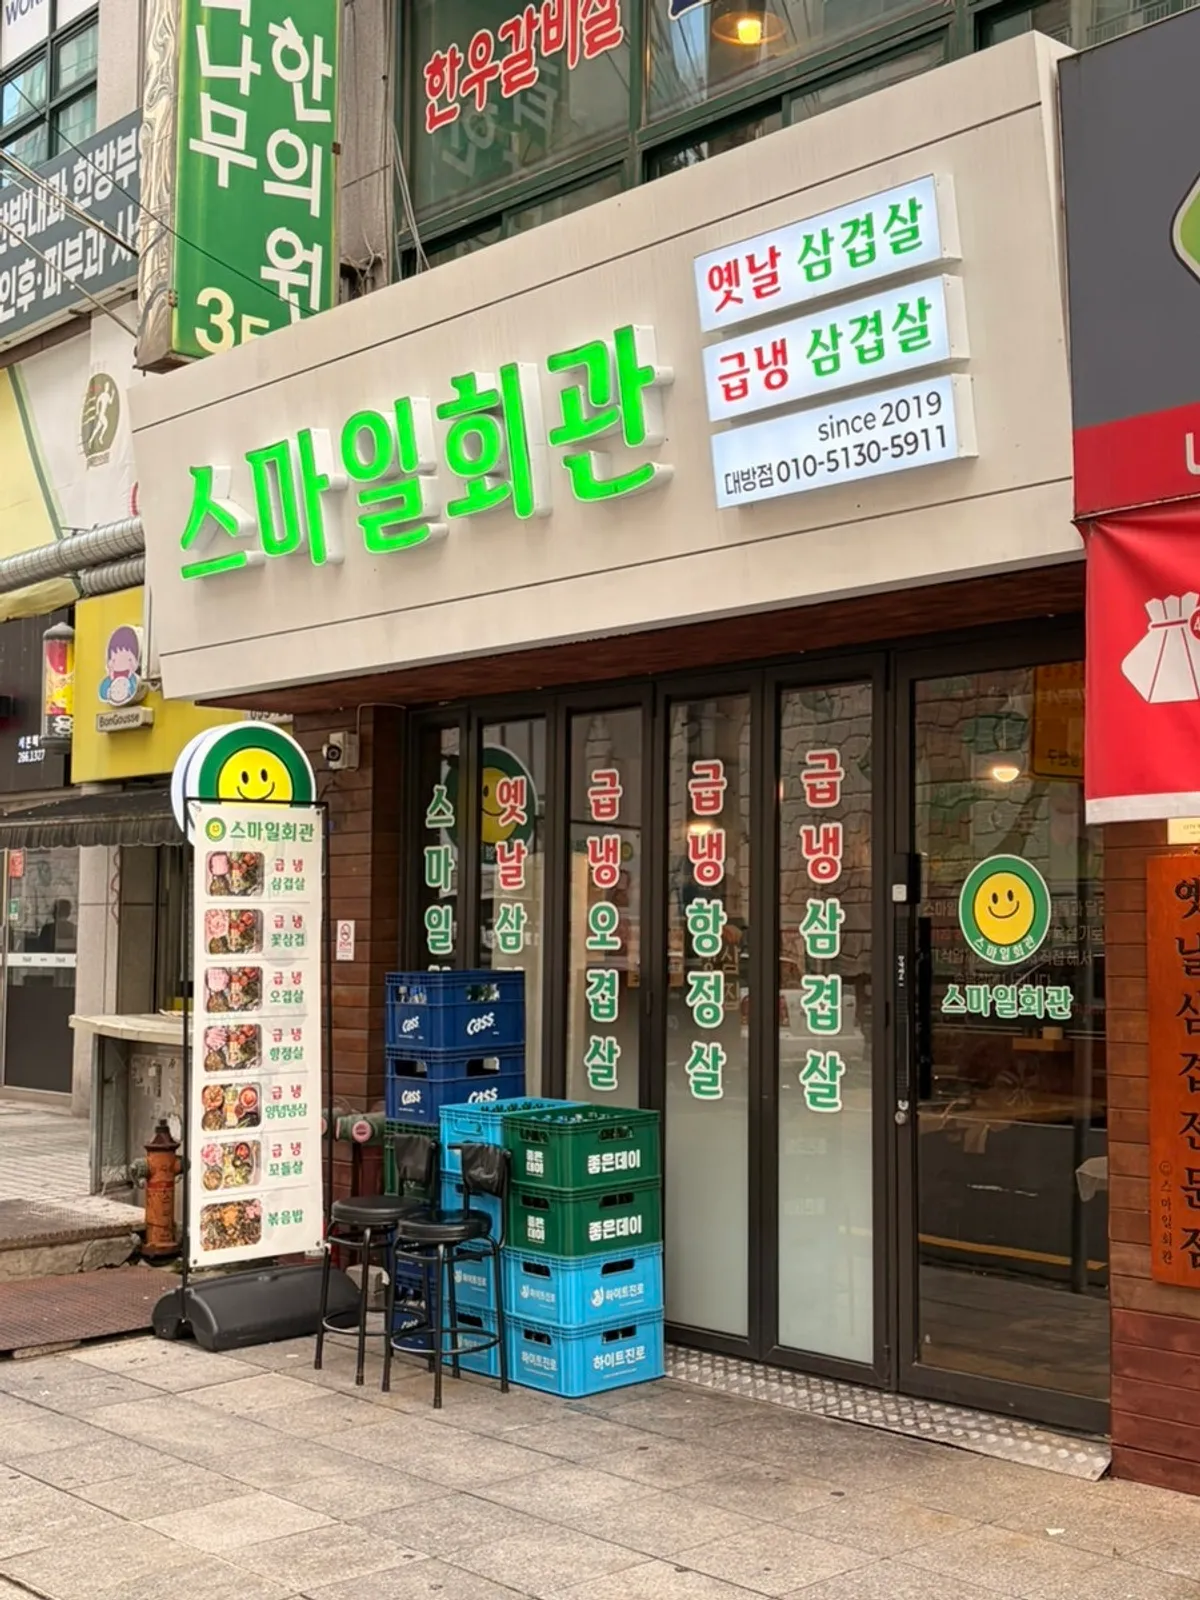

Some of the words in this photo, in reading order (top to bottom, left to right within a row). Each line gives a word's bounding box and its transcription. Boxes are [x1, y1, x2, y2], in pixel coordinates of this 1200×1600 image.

[423, 0, 625, 134] 한우갈비살
[189, 0, 262, 188] 나무
[260, 17, 333, 324] 한의원
[707, 244, 782, 313] 옛날
[796, 196, 923, 283] 삼겹살
[717, 336, 790, 402] 급냉
[805, 295, 933, 378] 삼겹살
[817, 411, 877, 442] since
[880, 390, 943, 428] 2019
[179, 324, 657, 582] 스마일회관
[724, 462, 774, 496] 대방점
[775, 424, 947, 484] 010-5130-5911
[229, 820, 314, 842] 스마일회관
[973, 937, 1036, 961] 스마일회관
[941, 984, 1074, 1020] 스마일회관
[402, 1016, 420, 1033] Cass
[467, 1012, 495, 1035] Cass
[402, 1090, 421, 1105] Cass
[468, 1087, 498, 1104] Cass
[587, 1149, 641, 1175] 좋은데이
[588, 1214, 642, 1242] 좋은데이
[605, 1283, 644, 1301] 하이트진로
[592, 1346, 646, 1370] 하이트진로
